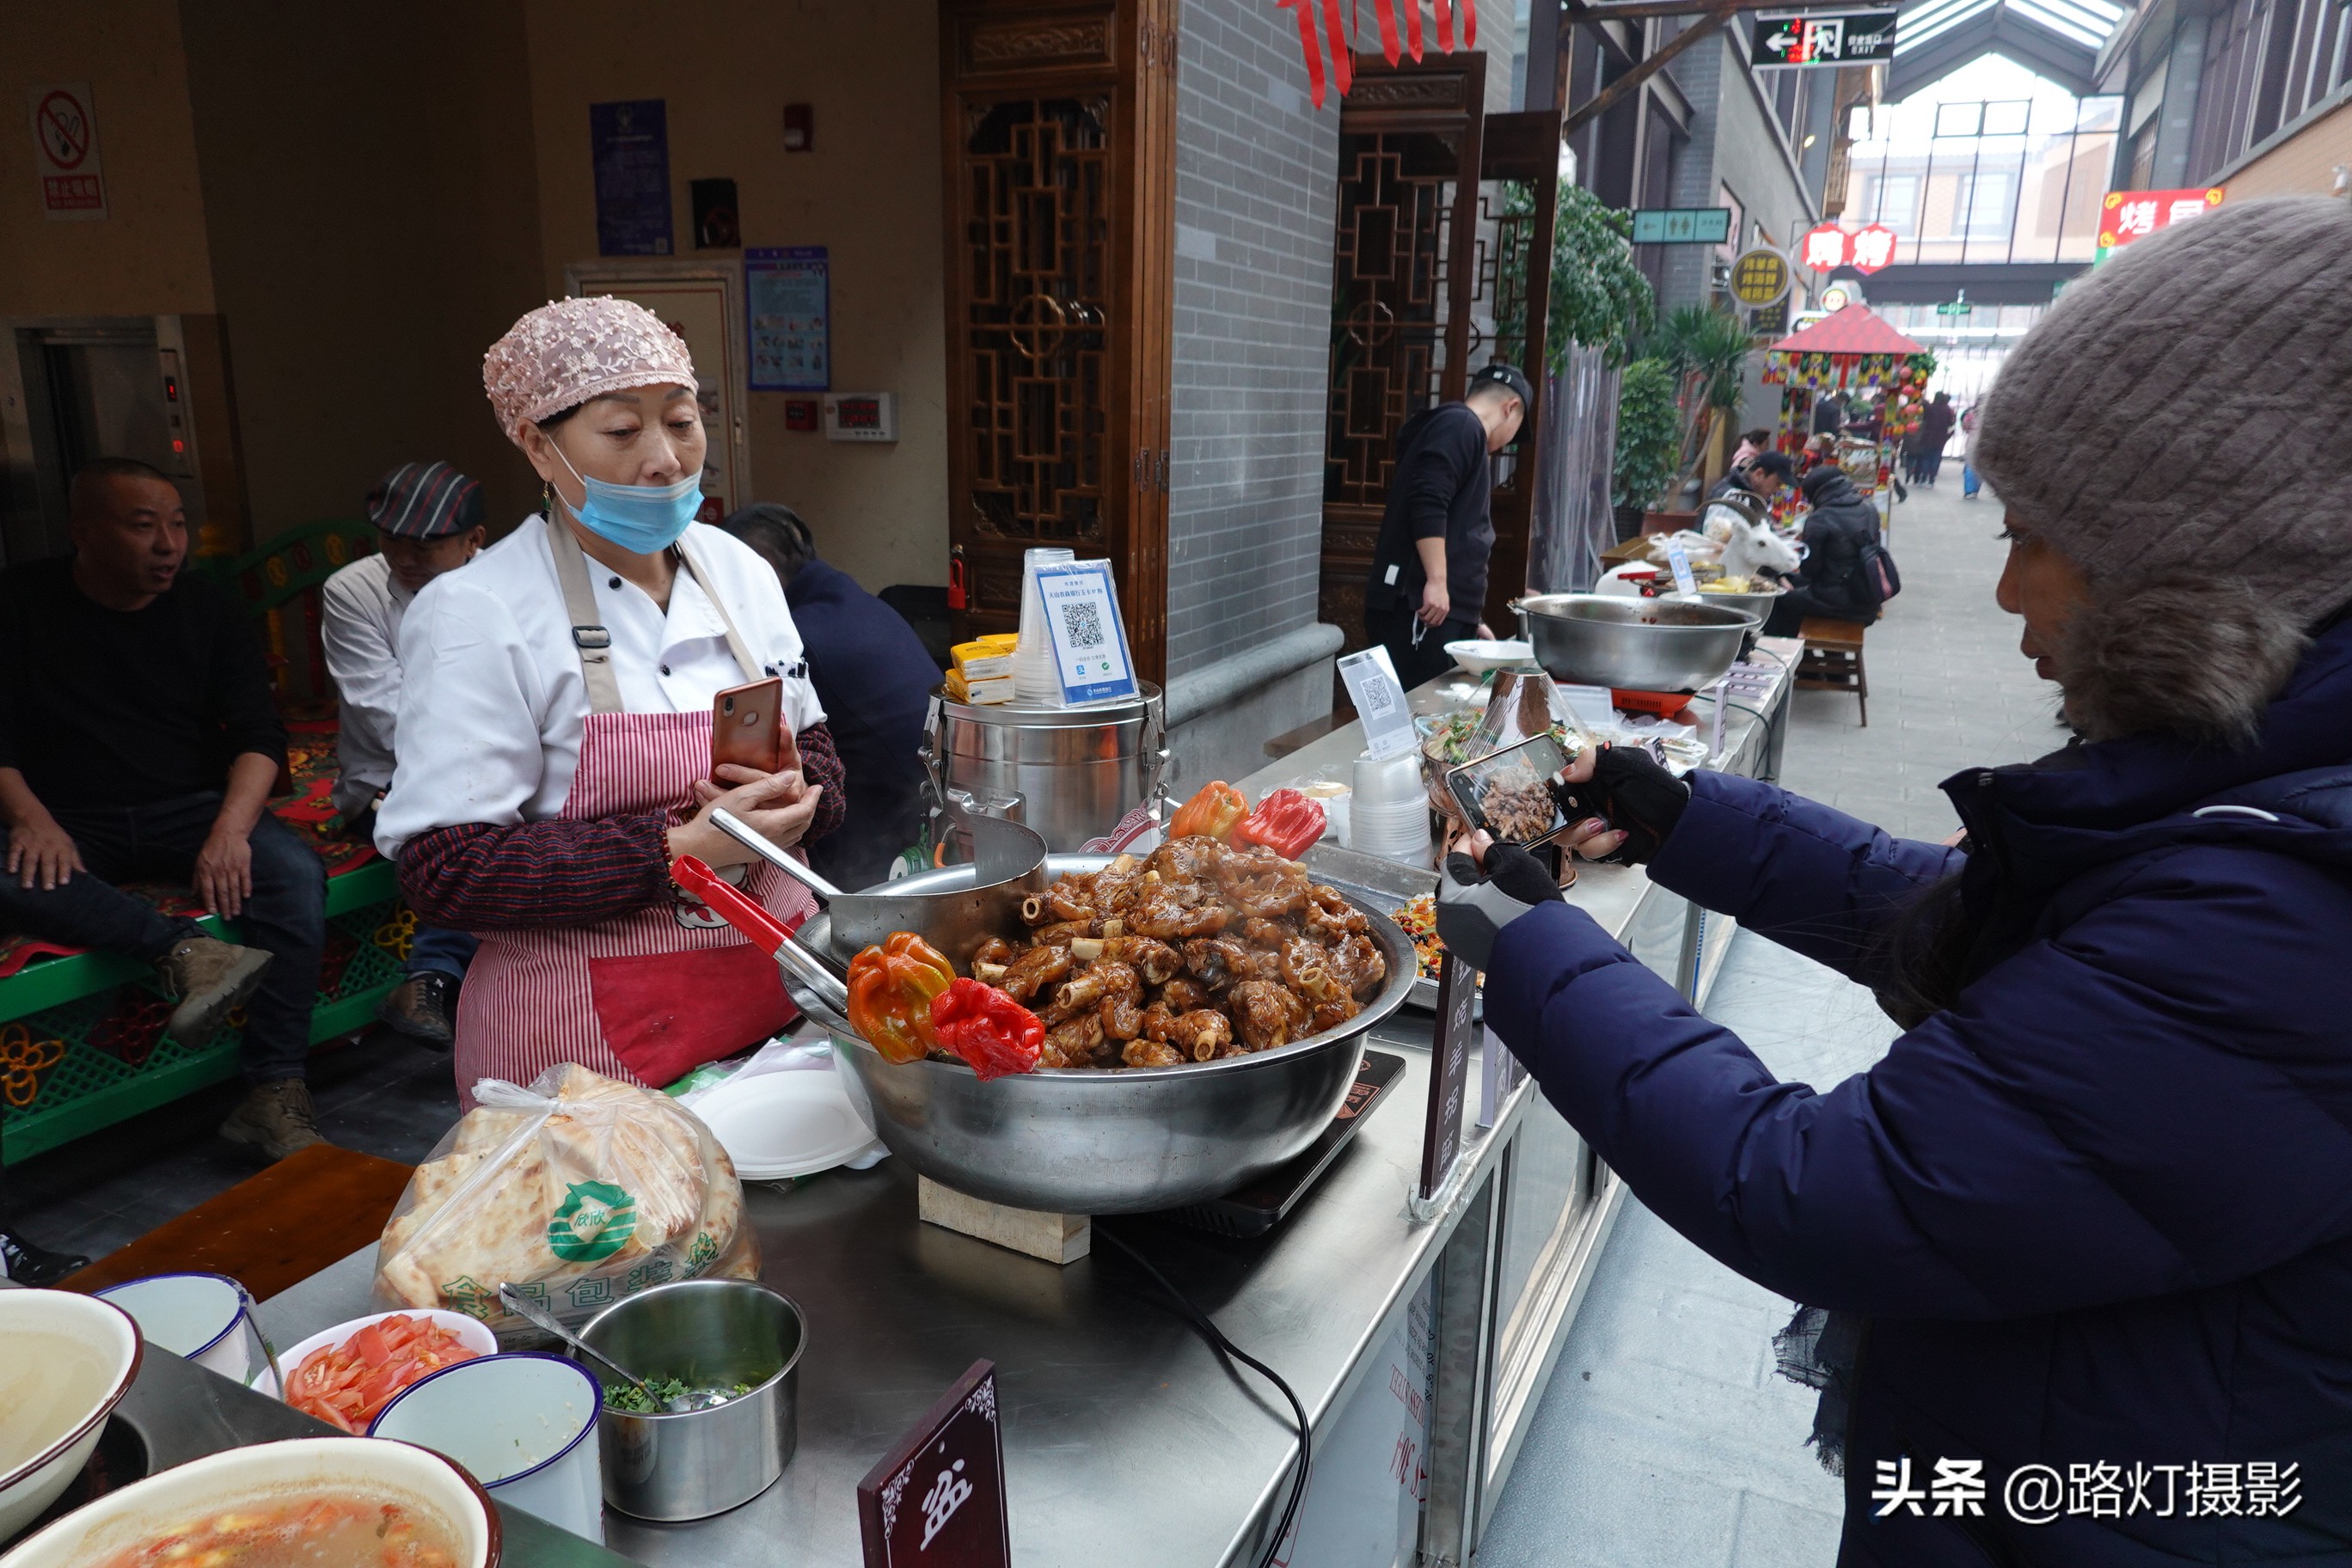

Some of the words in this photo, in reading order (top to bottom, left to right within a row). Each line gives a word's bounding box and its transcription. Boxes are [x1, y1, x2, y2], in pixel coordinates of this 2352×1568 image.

[1851, 45, 1876, 55] EXIT
[573, 1210, 606, 1228] 欣欣
[920, 1458, 973, 1552] 盆
